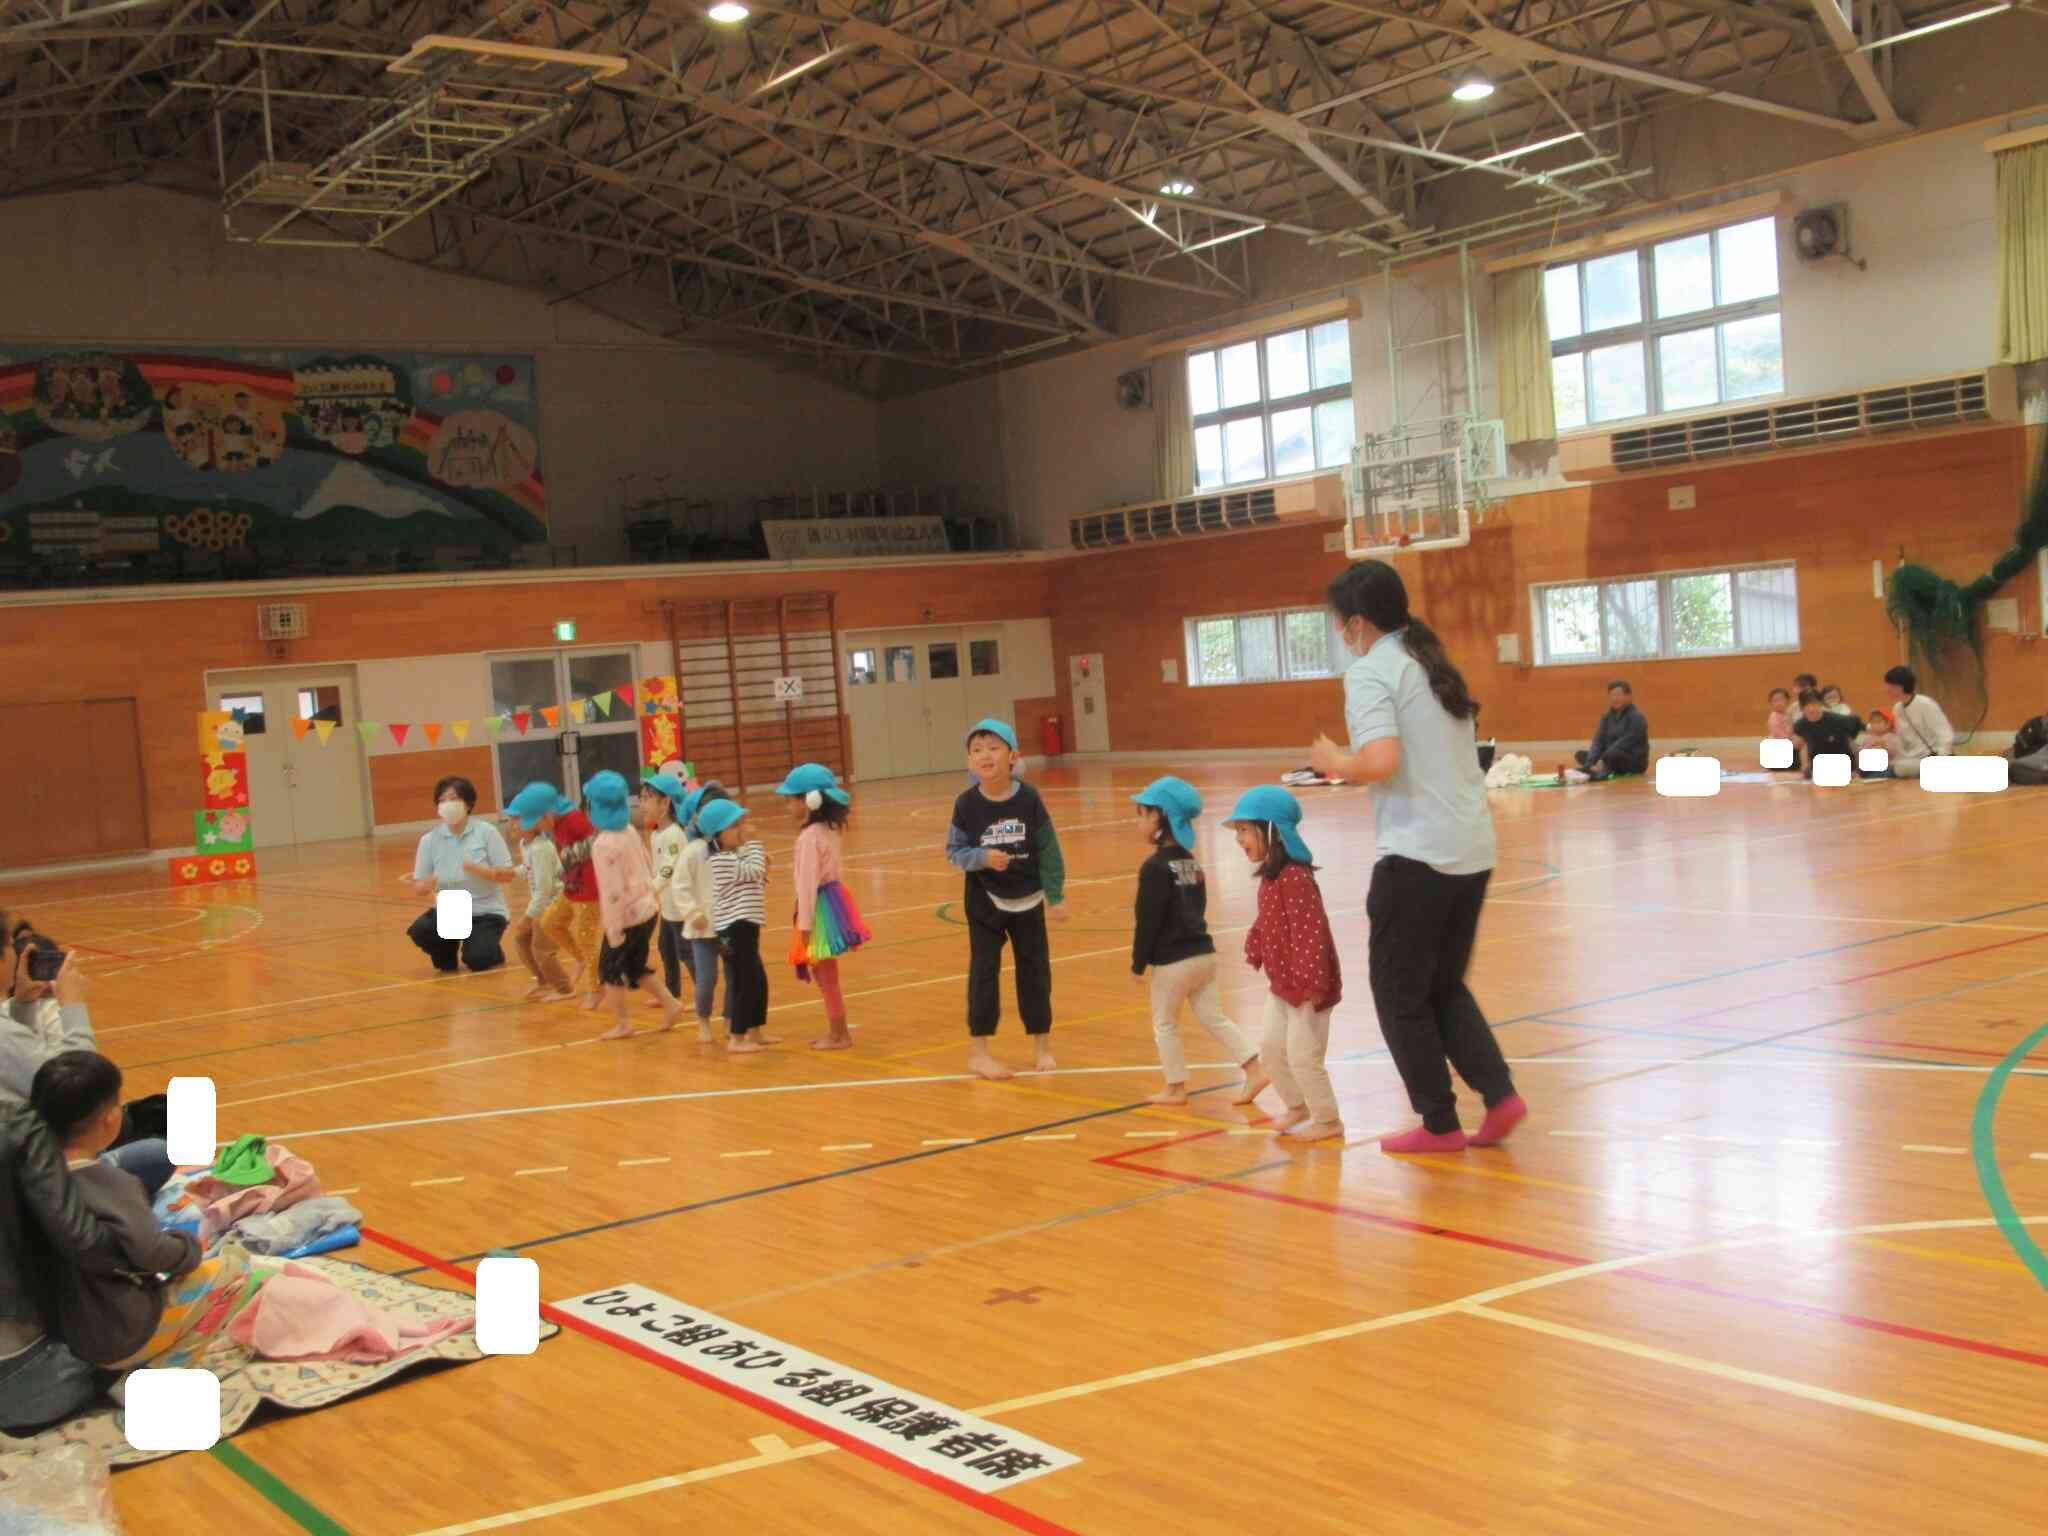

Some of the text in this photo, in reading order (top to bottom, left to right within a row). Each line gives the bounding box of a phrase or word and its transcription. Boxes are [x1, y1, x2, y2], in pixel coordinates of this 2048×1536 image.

[583, 1290, 1053, 1479] ひよこ組あひる組保護者席
